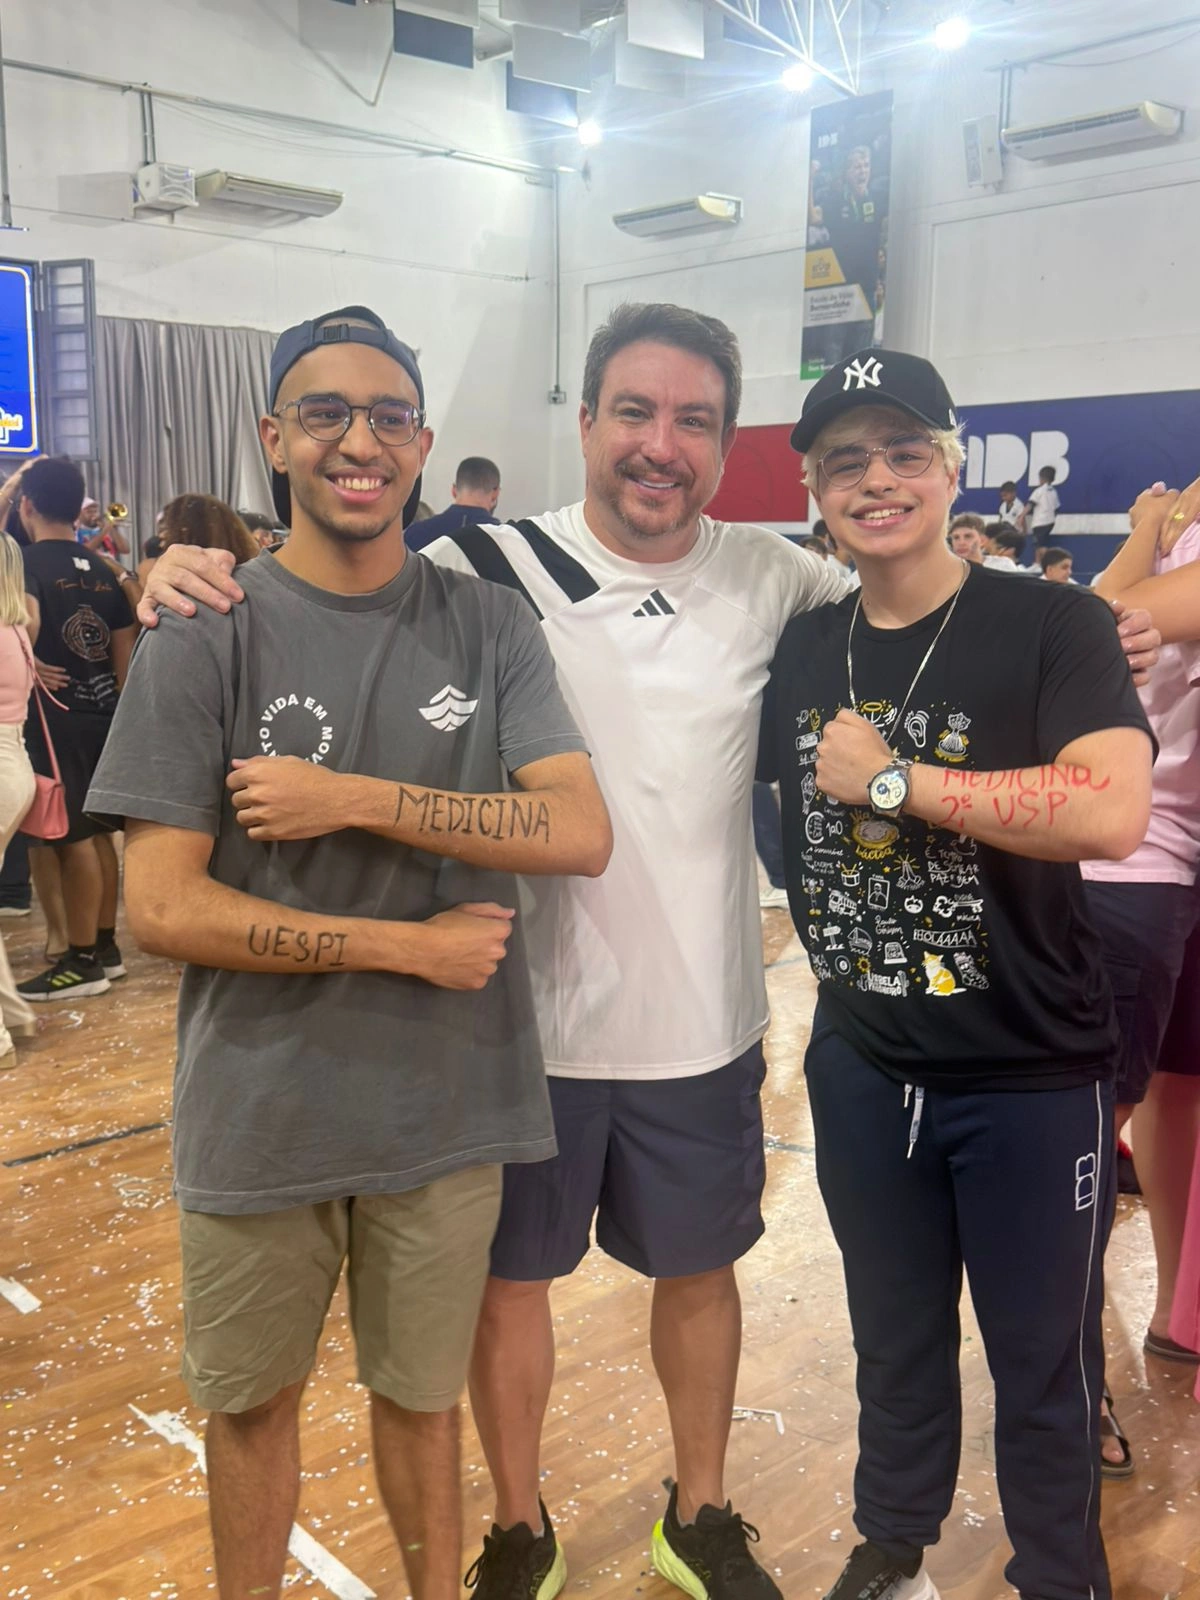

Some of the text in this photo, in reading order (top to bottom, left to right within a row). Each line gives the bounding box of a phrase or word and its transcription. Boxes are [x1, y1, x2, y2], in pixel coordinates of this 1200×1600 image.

[843, 357, 883, 391] NY
[261, 693, 299, 722] VIDA
[303, 696, 328, 721] EM
[393, 785, 549, 843] MEDICINA
[993, 791, 1068, 829] USP
[248, 924, 348, 967] UESPI
